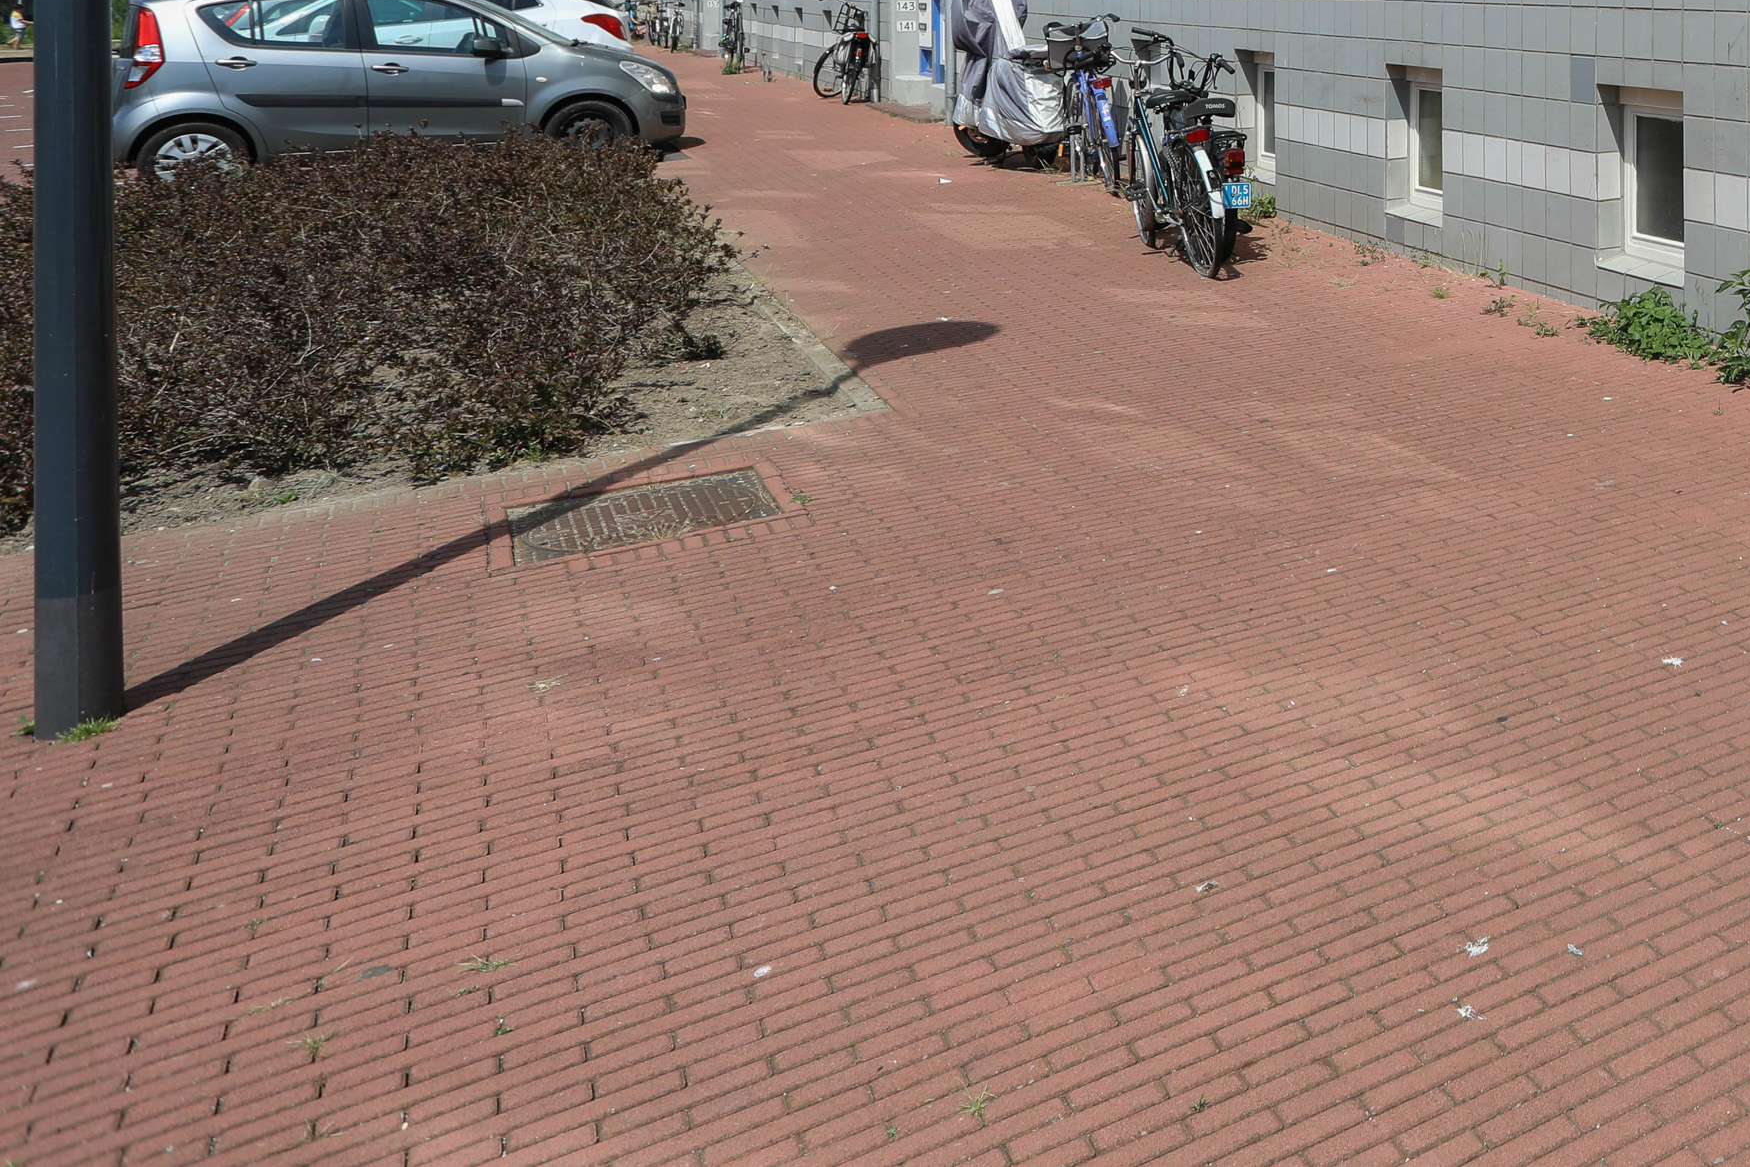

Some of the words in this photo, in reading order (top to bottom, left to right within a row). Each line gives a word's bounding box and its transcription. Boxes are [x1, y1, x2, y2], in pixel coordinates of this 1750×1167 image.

[897, 1, 915, 11] 143
[899, 21, 914, 31] 141
[1231, 196, 1249, 206] 66H
